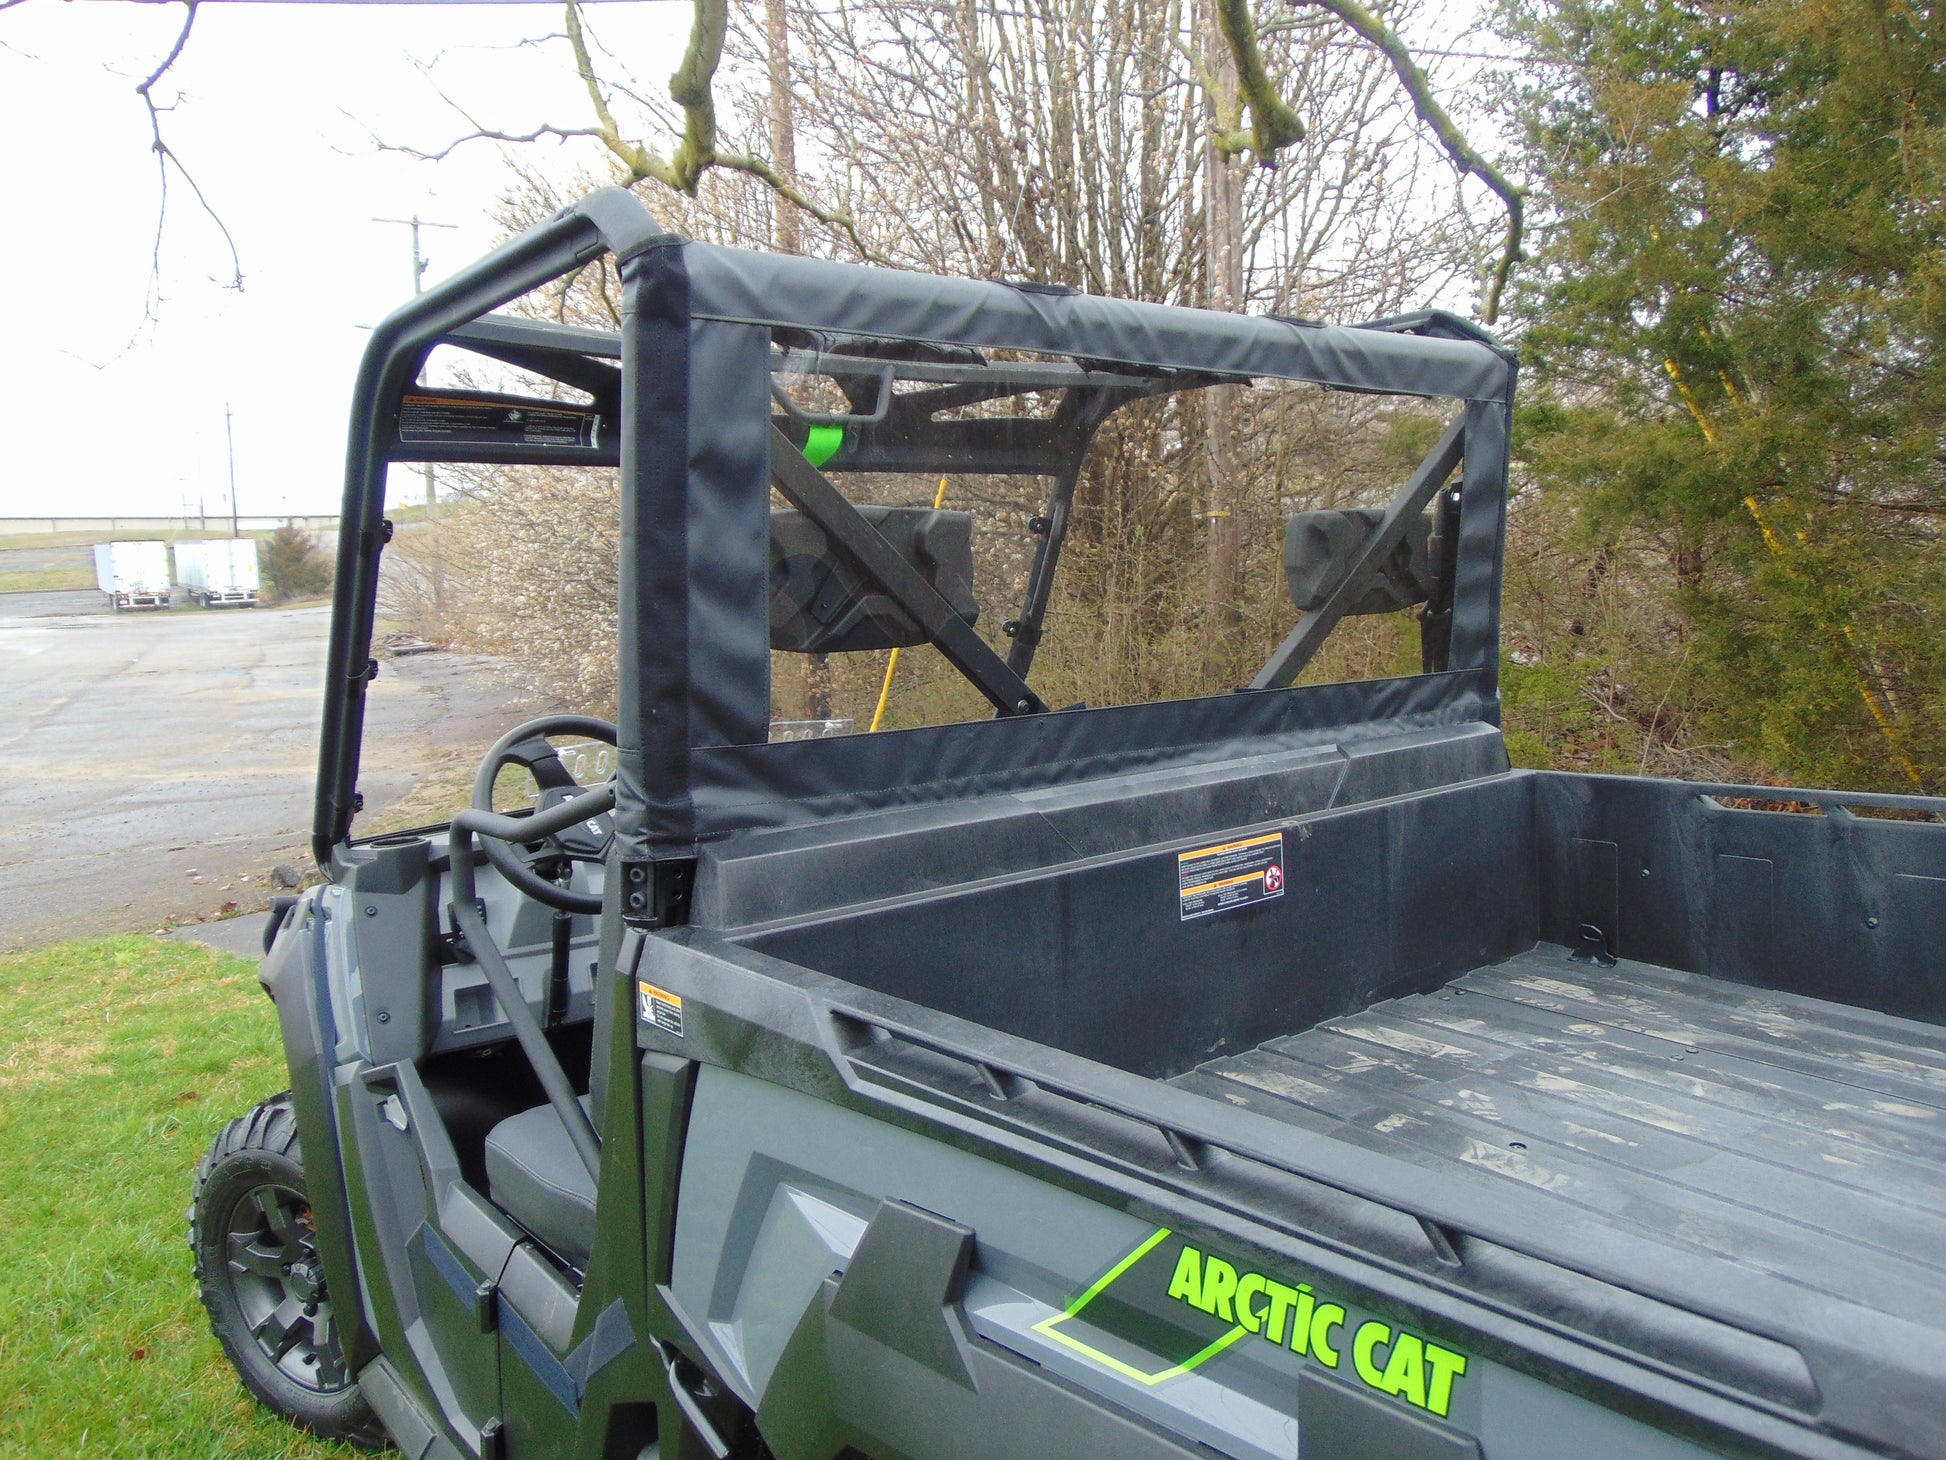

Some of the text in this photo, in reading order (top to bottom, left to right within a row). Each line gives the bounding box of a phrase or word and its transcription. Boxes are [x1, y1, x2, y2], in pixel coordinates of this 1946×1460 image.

[586, 820, 603, 835] CAT
[1168, 1245, 1467, 1417] ARCTIC CAT
